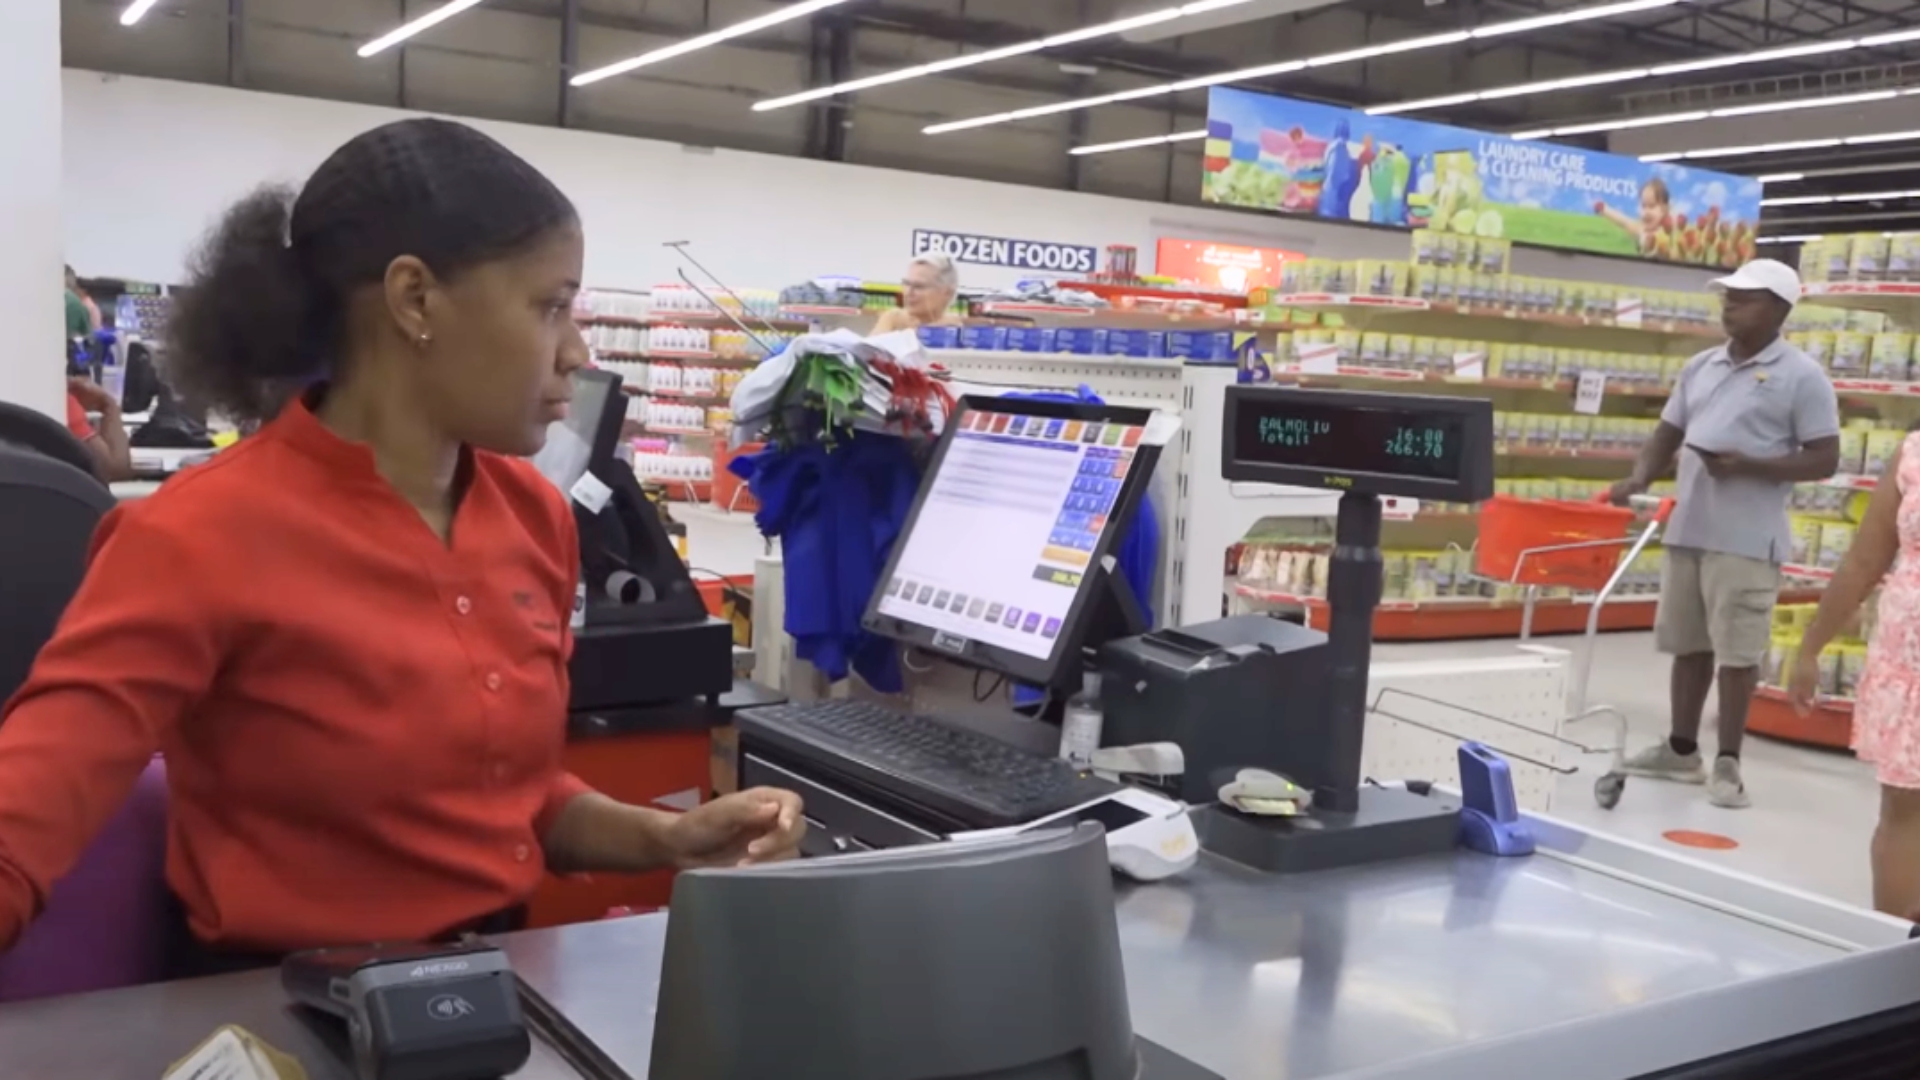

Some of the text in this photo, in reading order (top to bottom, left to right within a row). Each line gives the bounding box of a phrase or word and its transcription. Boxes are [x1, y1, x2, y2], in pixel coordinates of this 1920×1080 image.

[1478, 139, 1586, 173] LAUNDRY CARE
[1491, 161, 1564, 187] CLEANING
[1565, 172, 1638, 198] PRODUCTS
[914, 231, 1092, 271] FROZEN FOODS
[1385, 439, 1443, 458] 266.70
